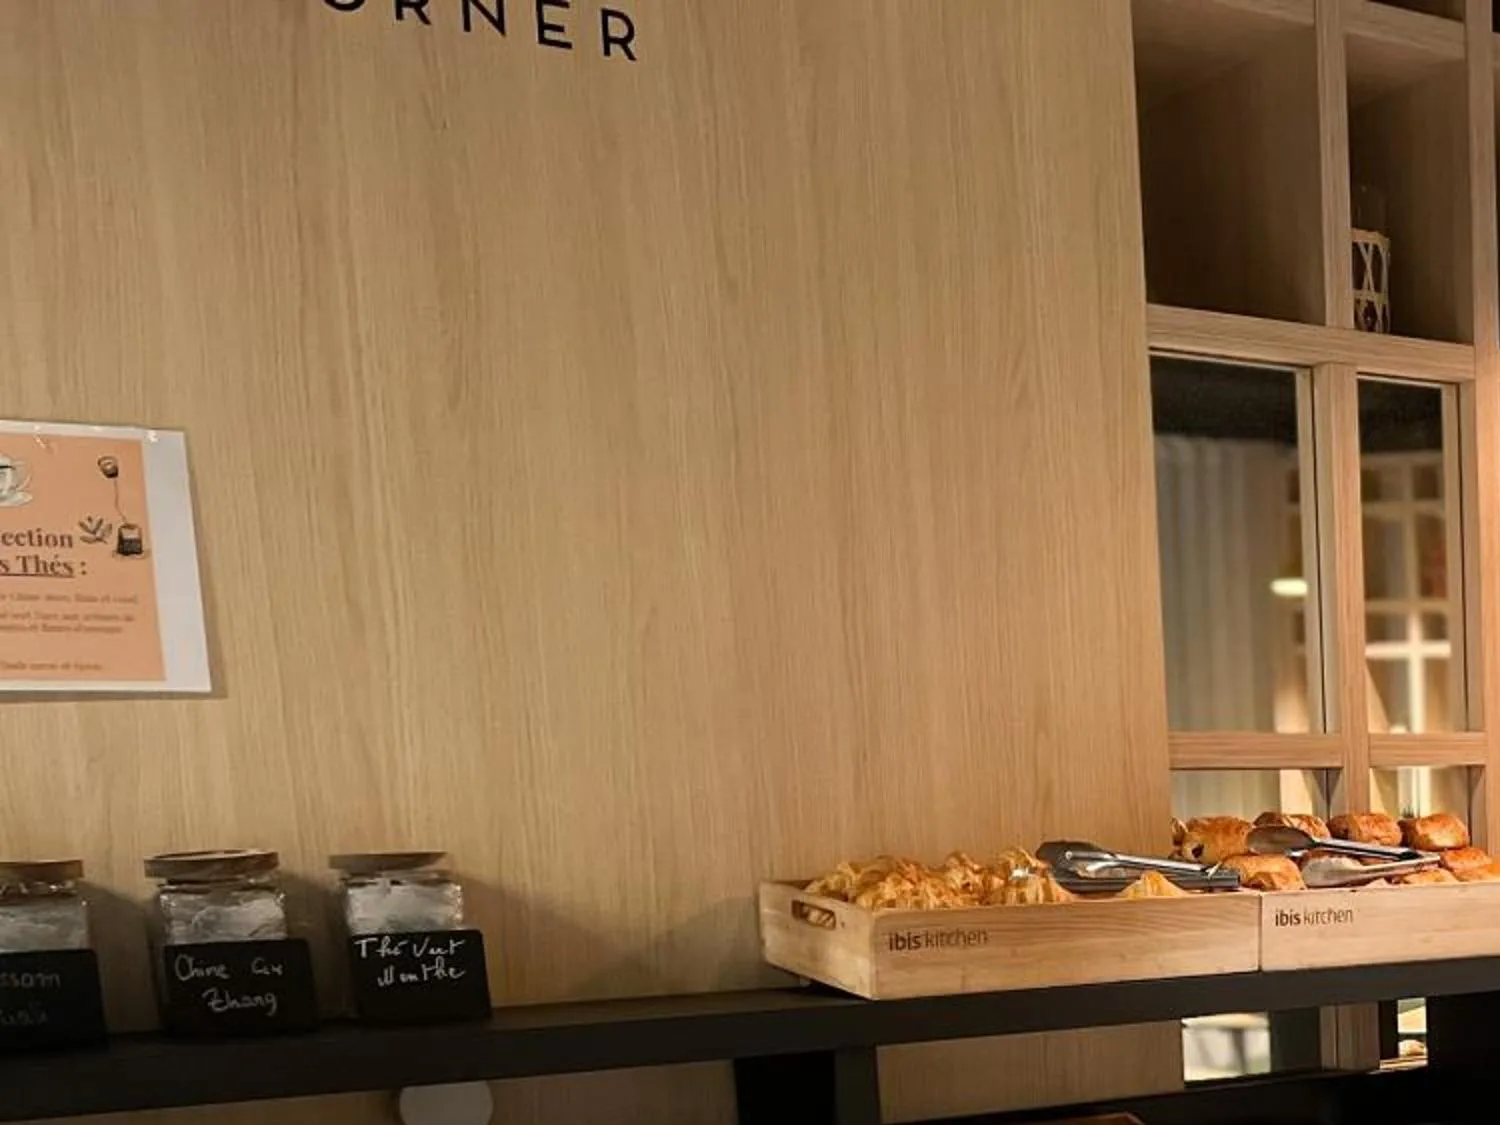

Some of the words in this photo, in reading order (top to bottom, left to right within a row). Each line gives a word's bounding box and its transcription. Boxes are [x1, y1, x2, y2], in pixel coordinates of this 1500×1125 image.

[323, 0, 637, 61] RNER
[1274, 908, 1301, 927] ibis
[1303, 906, 1353, 925] kitchen
[888, 931, 922, 951] ibis
[924, 927, 989, 949] kitchen
